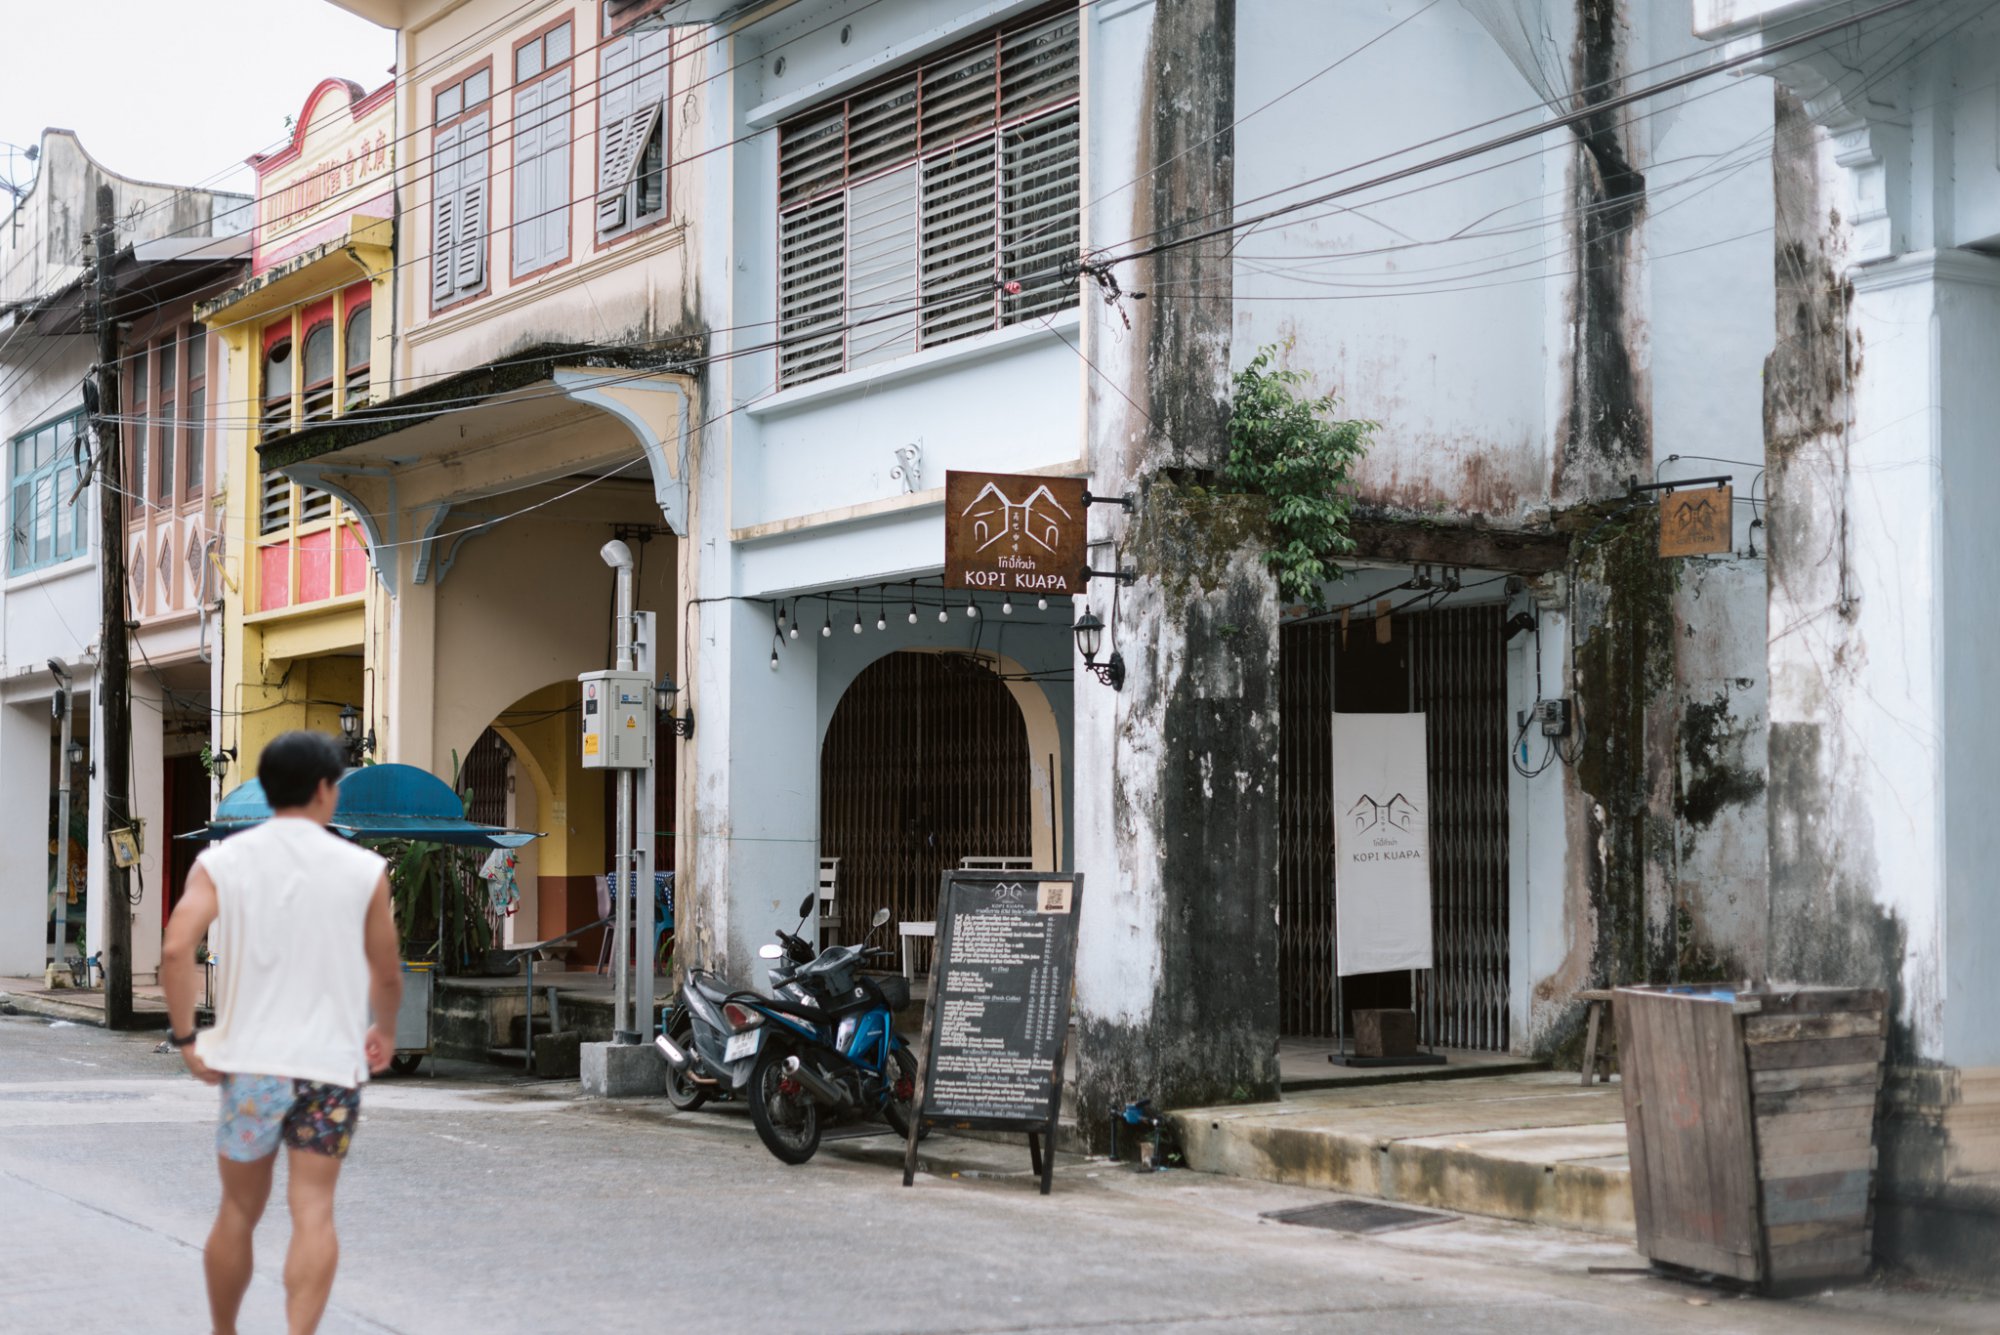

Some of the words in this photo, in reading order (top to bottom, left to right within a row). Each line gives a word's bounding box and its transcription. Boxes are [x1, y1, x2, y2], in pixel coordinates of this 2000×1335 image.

[965, 571, 1006, 587] KOPI
[1015, 573, 1067, 589] KUAPA
[1353, 852, 1379, 862] KOPI
[1384, 850, 1421, 860] KUAPA
